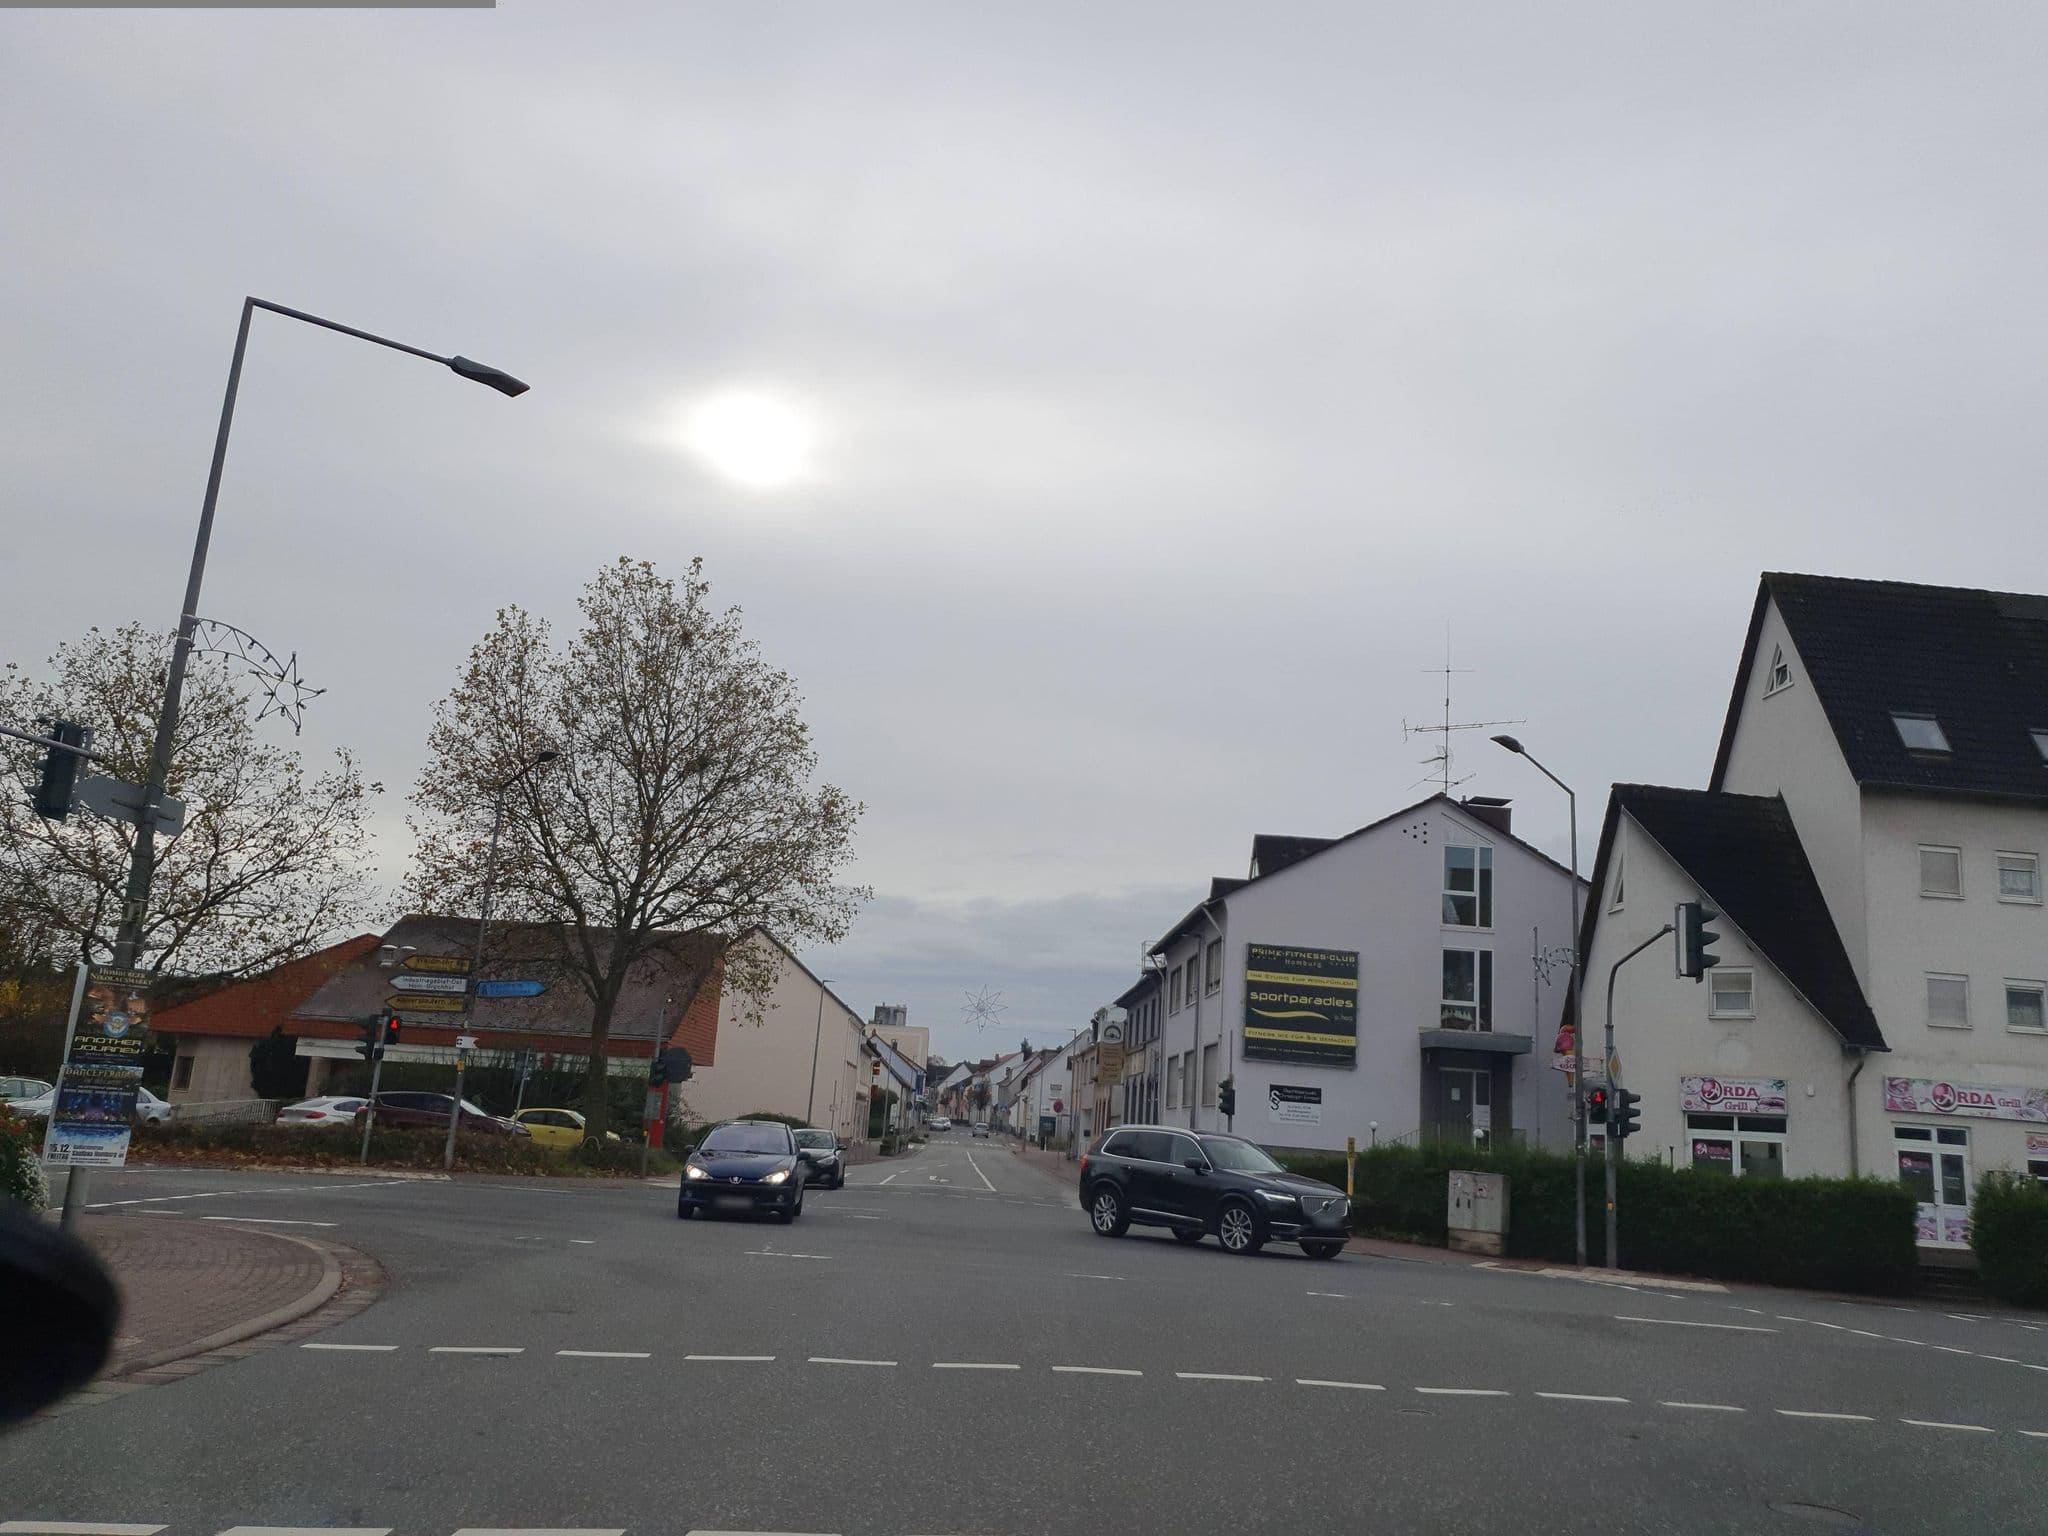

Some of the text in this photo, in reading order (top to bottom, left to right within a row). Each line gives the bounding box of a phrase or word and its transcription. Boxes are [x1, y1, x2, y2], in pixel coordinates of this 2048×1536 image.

[1250, 991, 1354, 1008] sportparadies
[74, 1035, 142, 1046] ANOTHER
[1724, 1101, 1749, 1111] Grill
